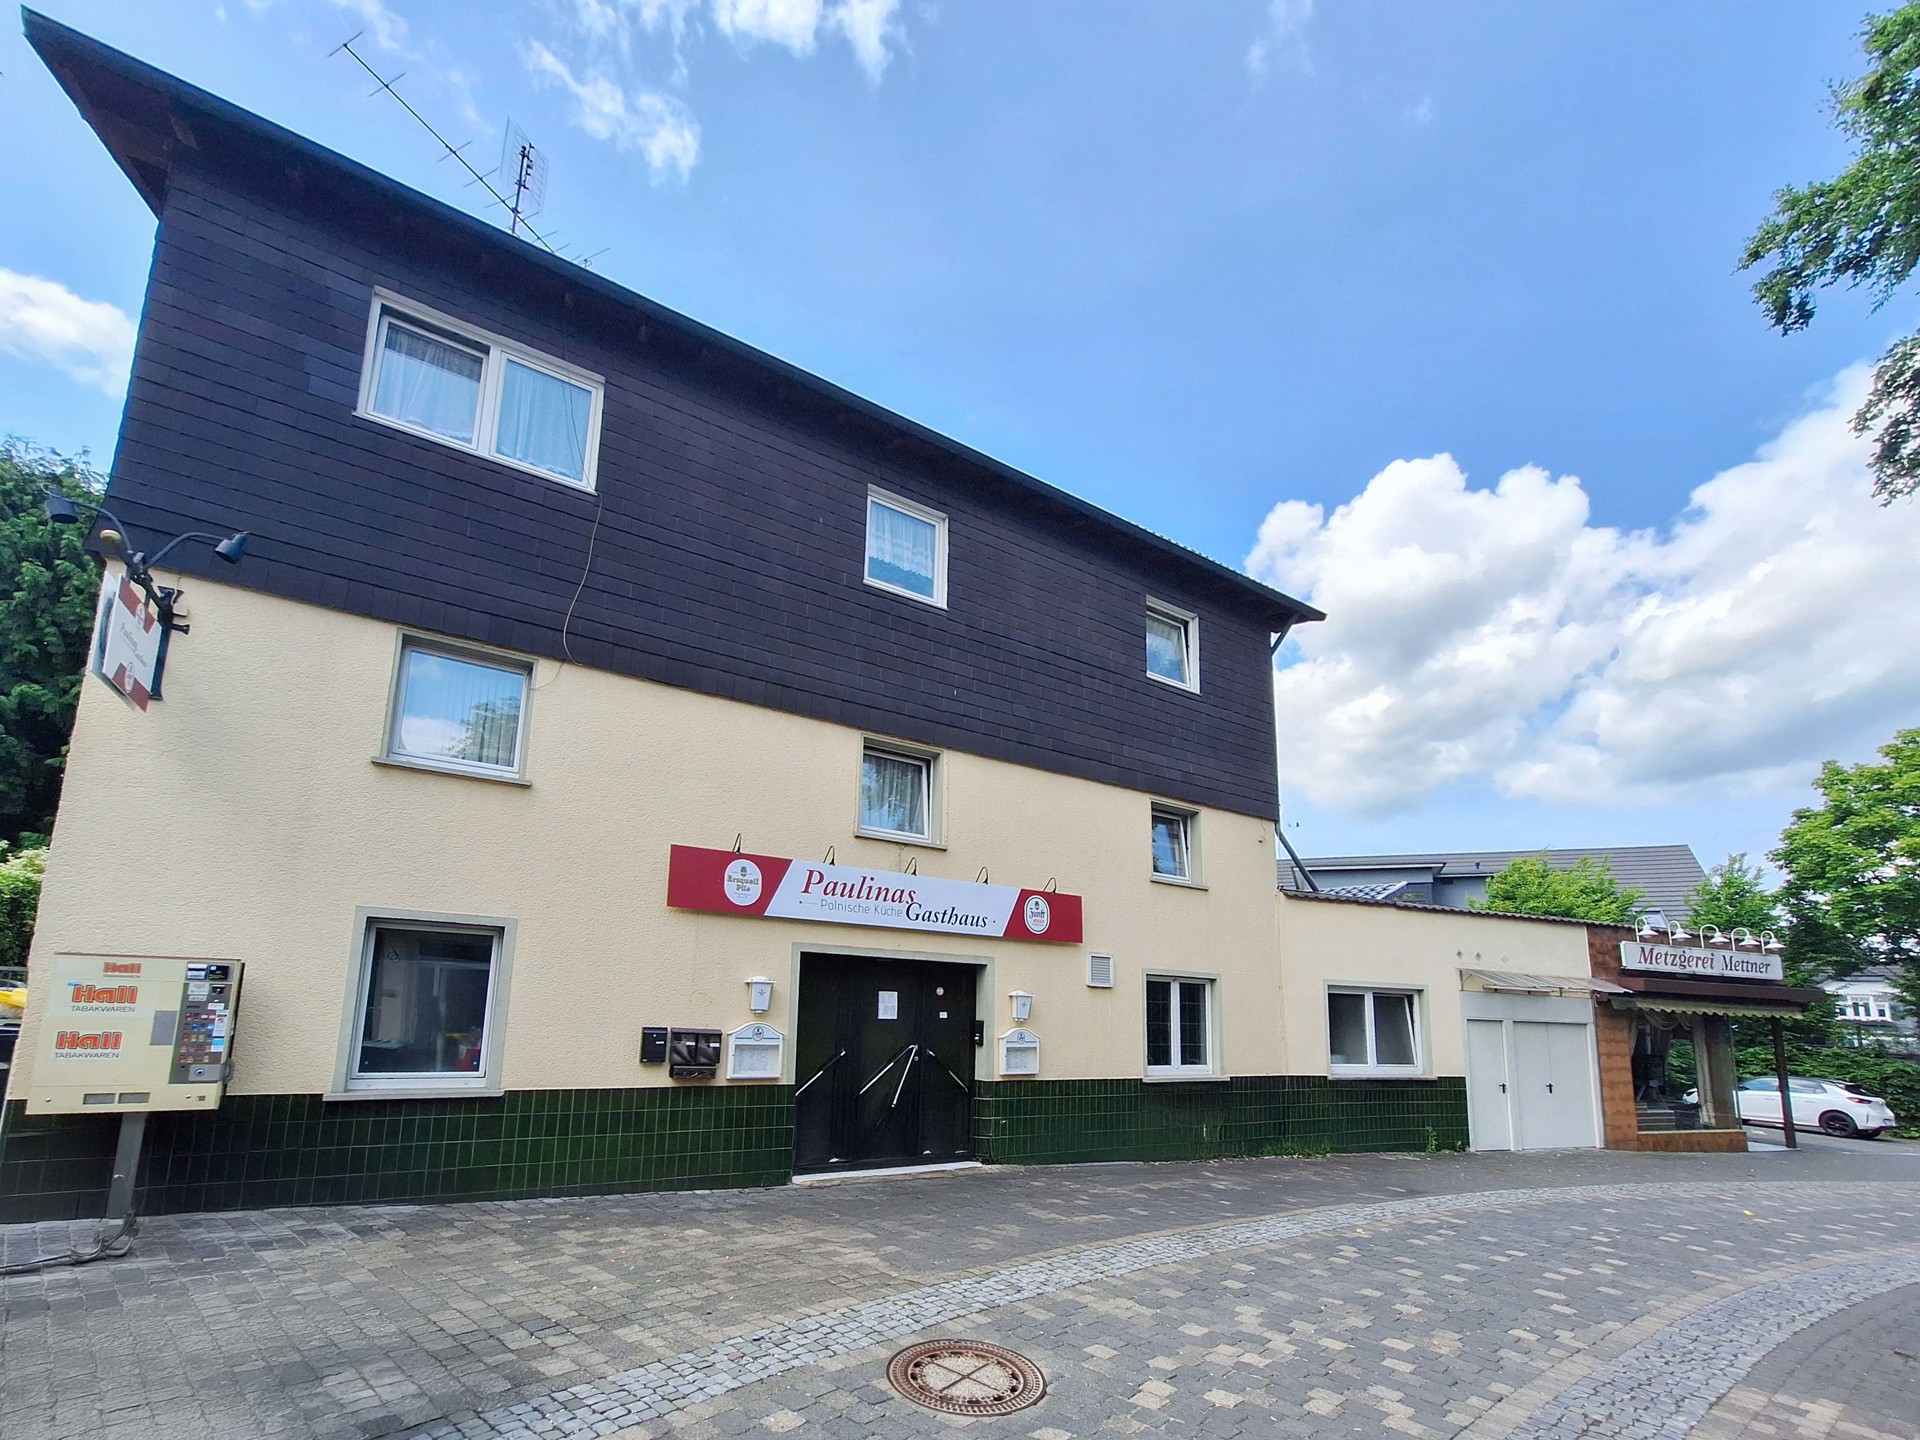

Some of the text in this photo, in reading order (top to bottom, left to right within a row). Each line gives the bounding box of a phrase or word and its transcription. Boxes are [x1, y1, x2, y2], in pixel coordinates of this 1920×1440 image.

[800, 868, 917, 904] Paulinas
[820, 899, 903, 918] Polnische Küche
[905, 901, 988, 928] Gasthaus
[1637, 946, 1771, 974] Metzgerei Mettner
[71, 984, 138, 1004] Hall
[70, 1005, 136, 1013] TABAKWAREN
[55, 1030, 122, 1050] Hall
[54, 1051, 120, 1059] TABAKWAREN
